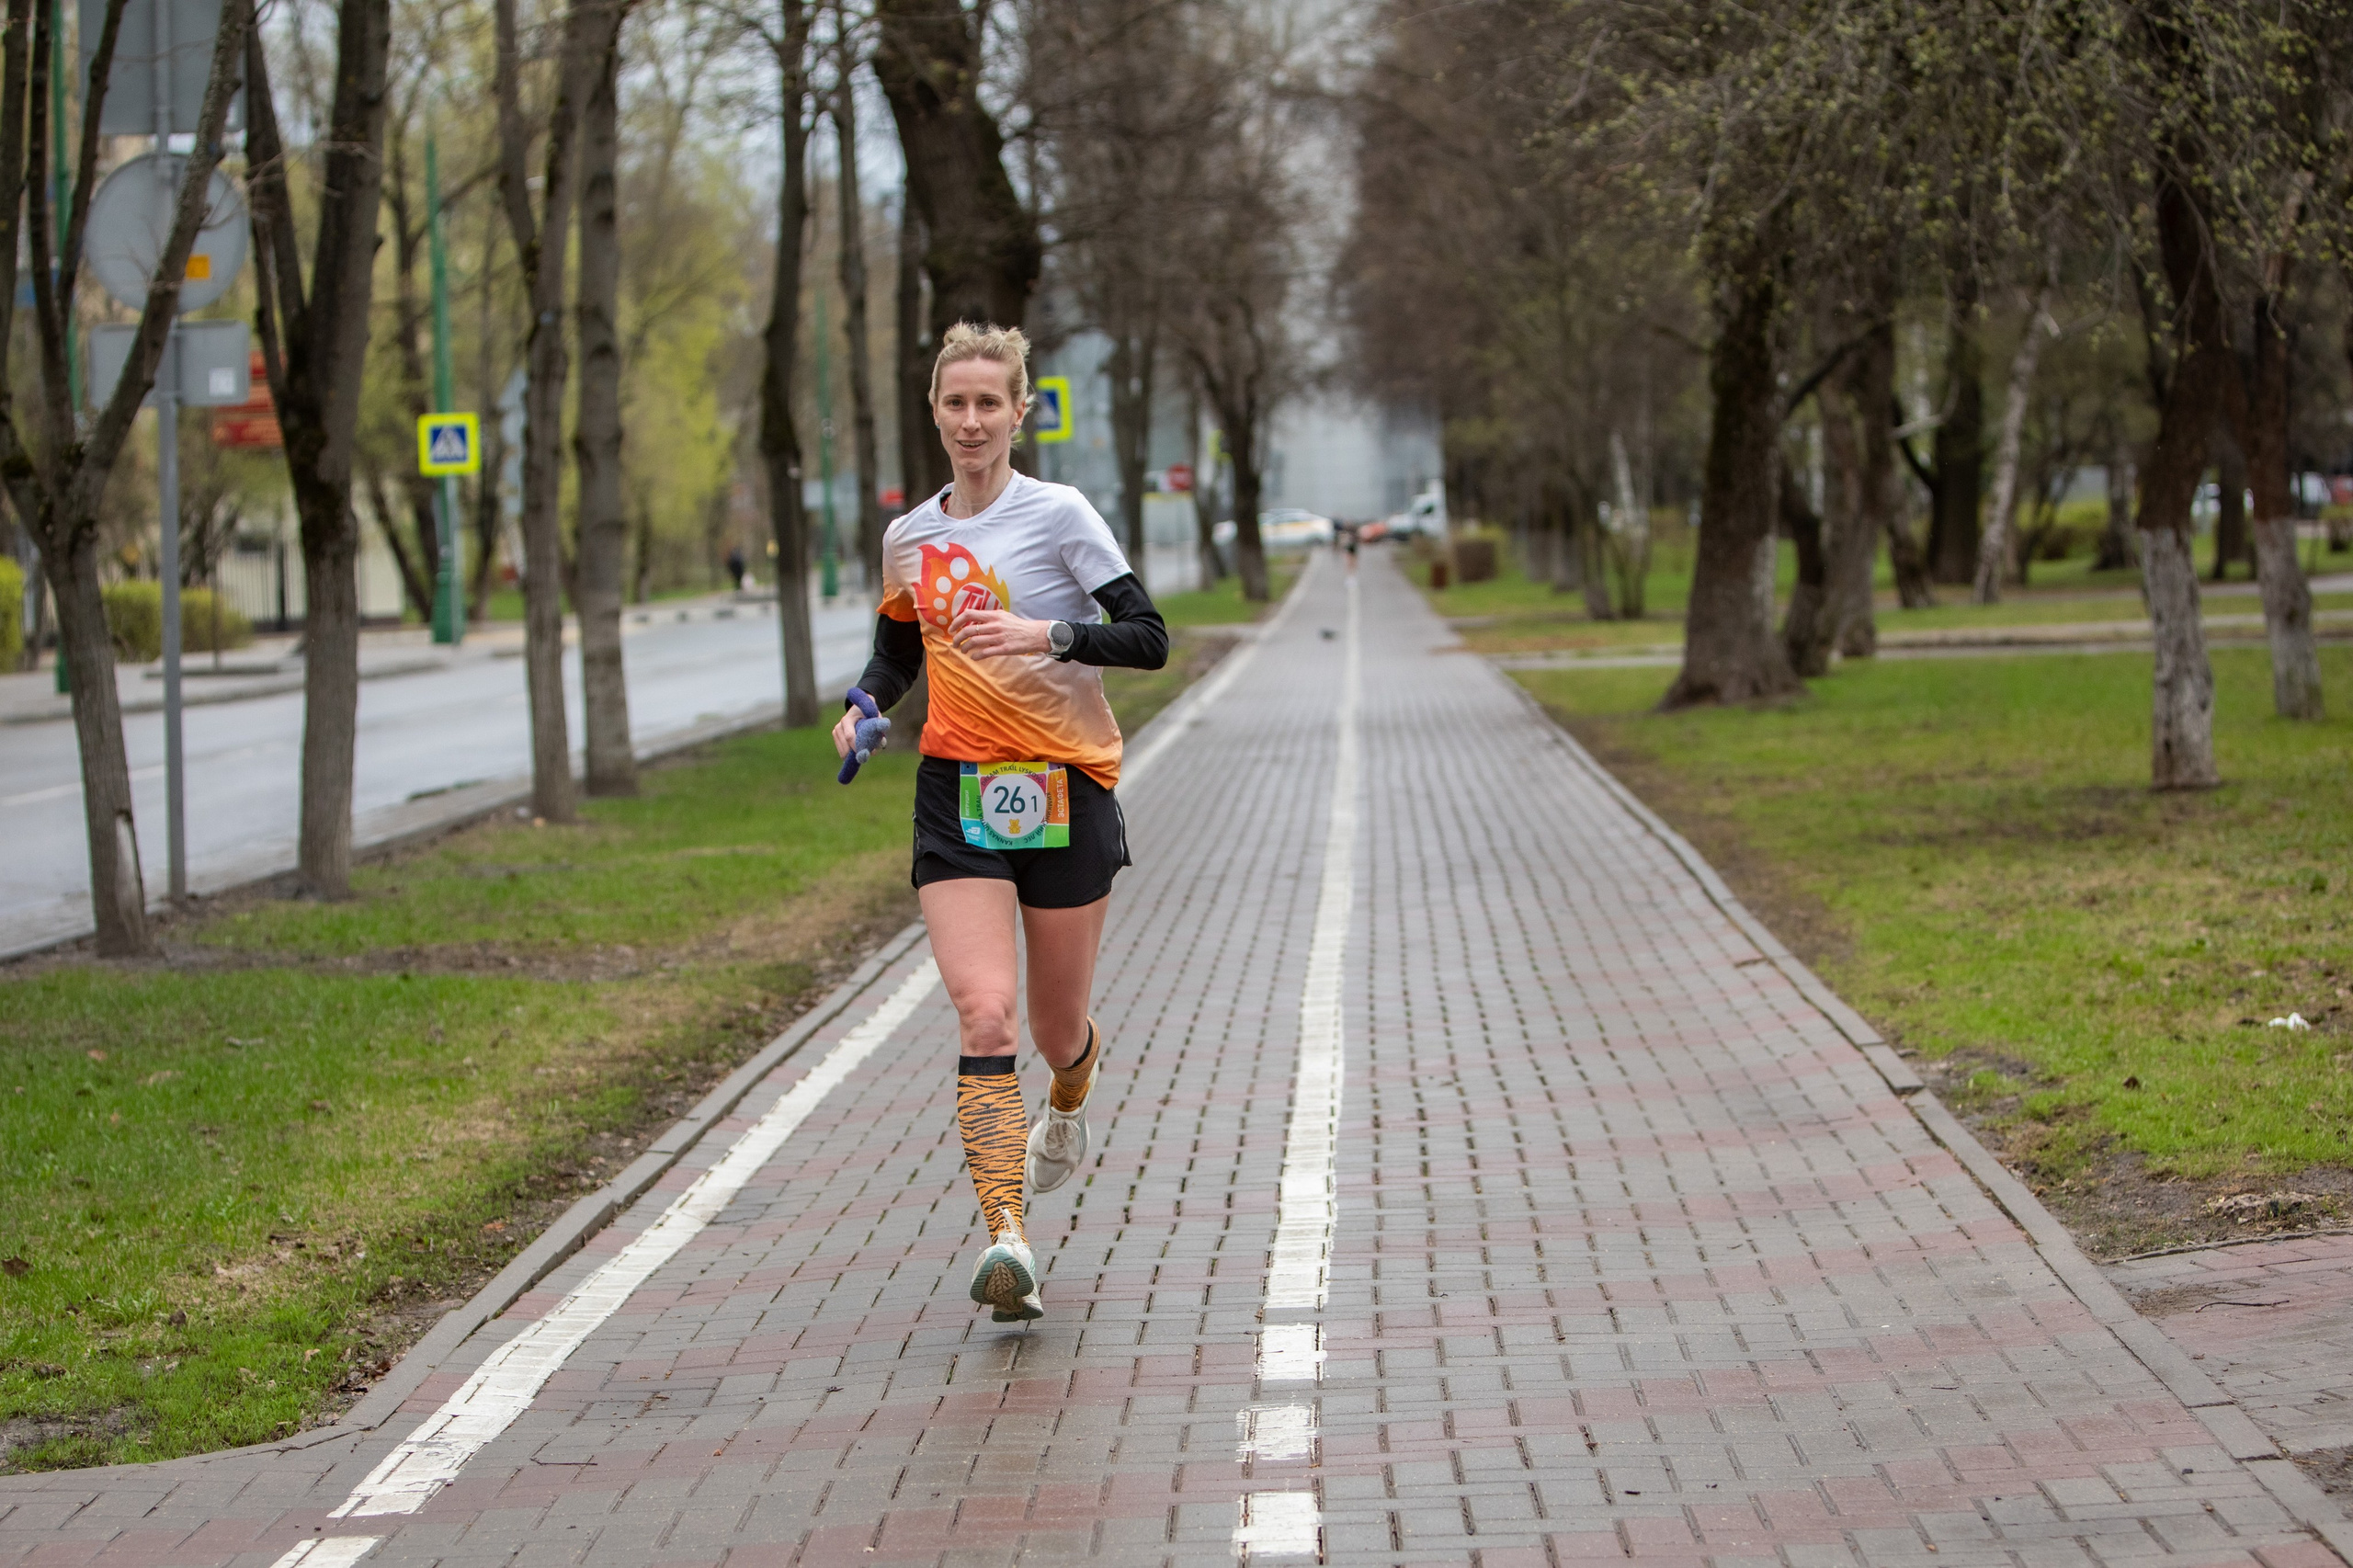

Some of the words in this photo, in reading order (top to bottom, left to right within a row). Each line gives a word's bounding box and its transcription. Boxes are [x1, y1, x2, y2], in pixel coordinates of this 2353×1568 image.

[982, 769, 999, 786] DREAM
[1018, 767, 1043, 784] LYSKOVO
[1056, 778, 1064, 818] ЭСТАФЕТА
[988, 830, 1013, 846] KANNAS
[1023, 833, 1035, 844] ЛЕС
